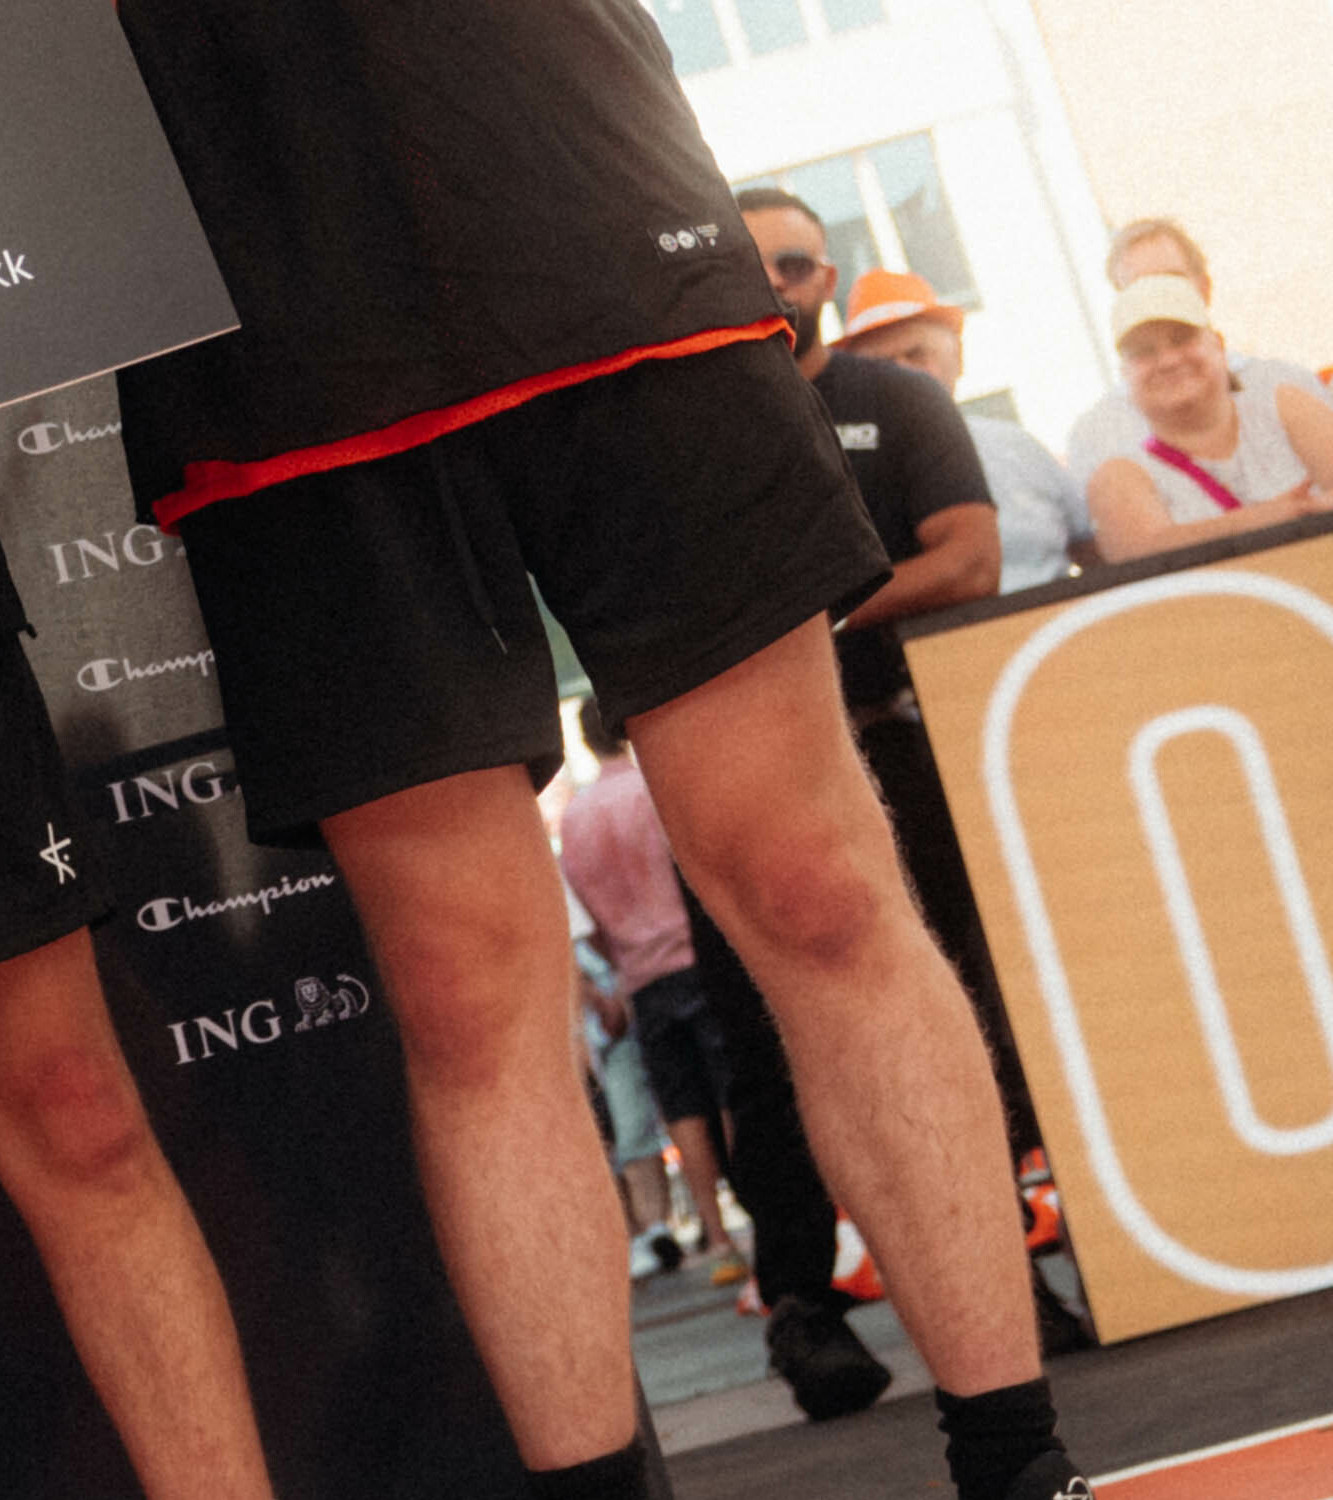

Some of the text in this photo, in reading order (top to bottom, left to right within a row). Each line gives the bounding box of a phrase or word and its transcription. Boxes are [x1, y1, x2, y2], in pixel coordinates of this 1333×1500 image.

[18, 420, 122, 455] Cham
[49, 524, 164, 584] ING
[77, 649, 215, 693] Champ
[106, 761, 223, 824] ING
[137, 870, 336, 932] Champion
[167, 1000, 282, 1066] ING
